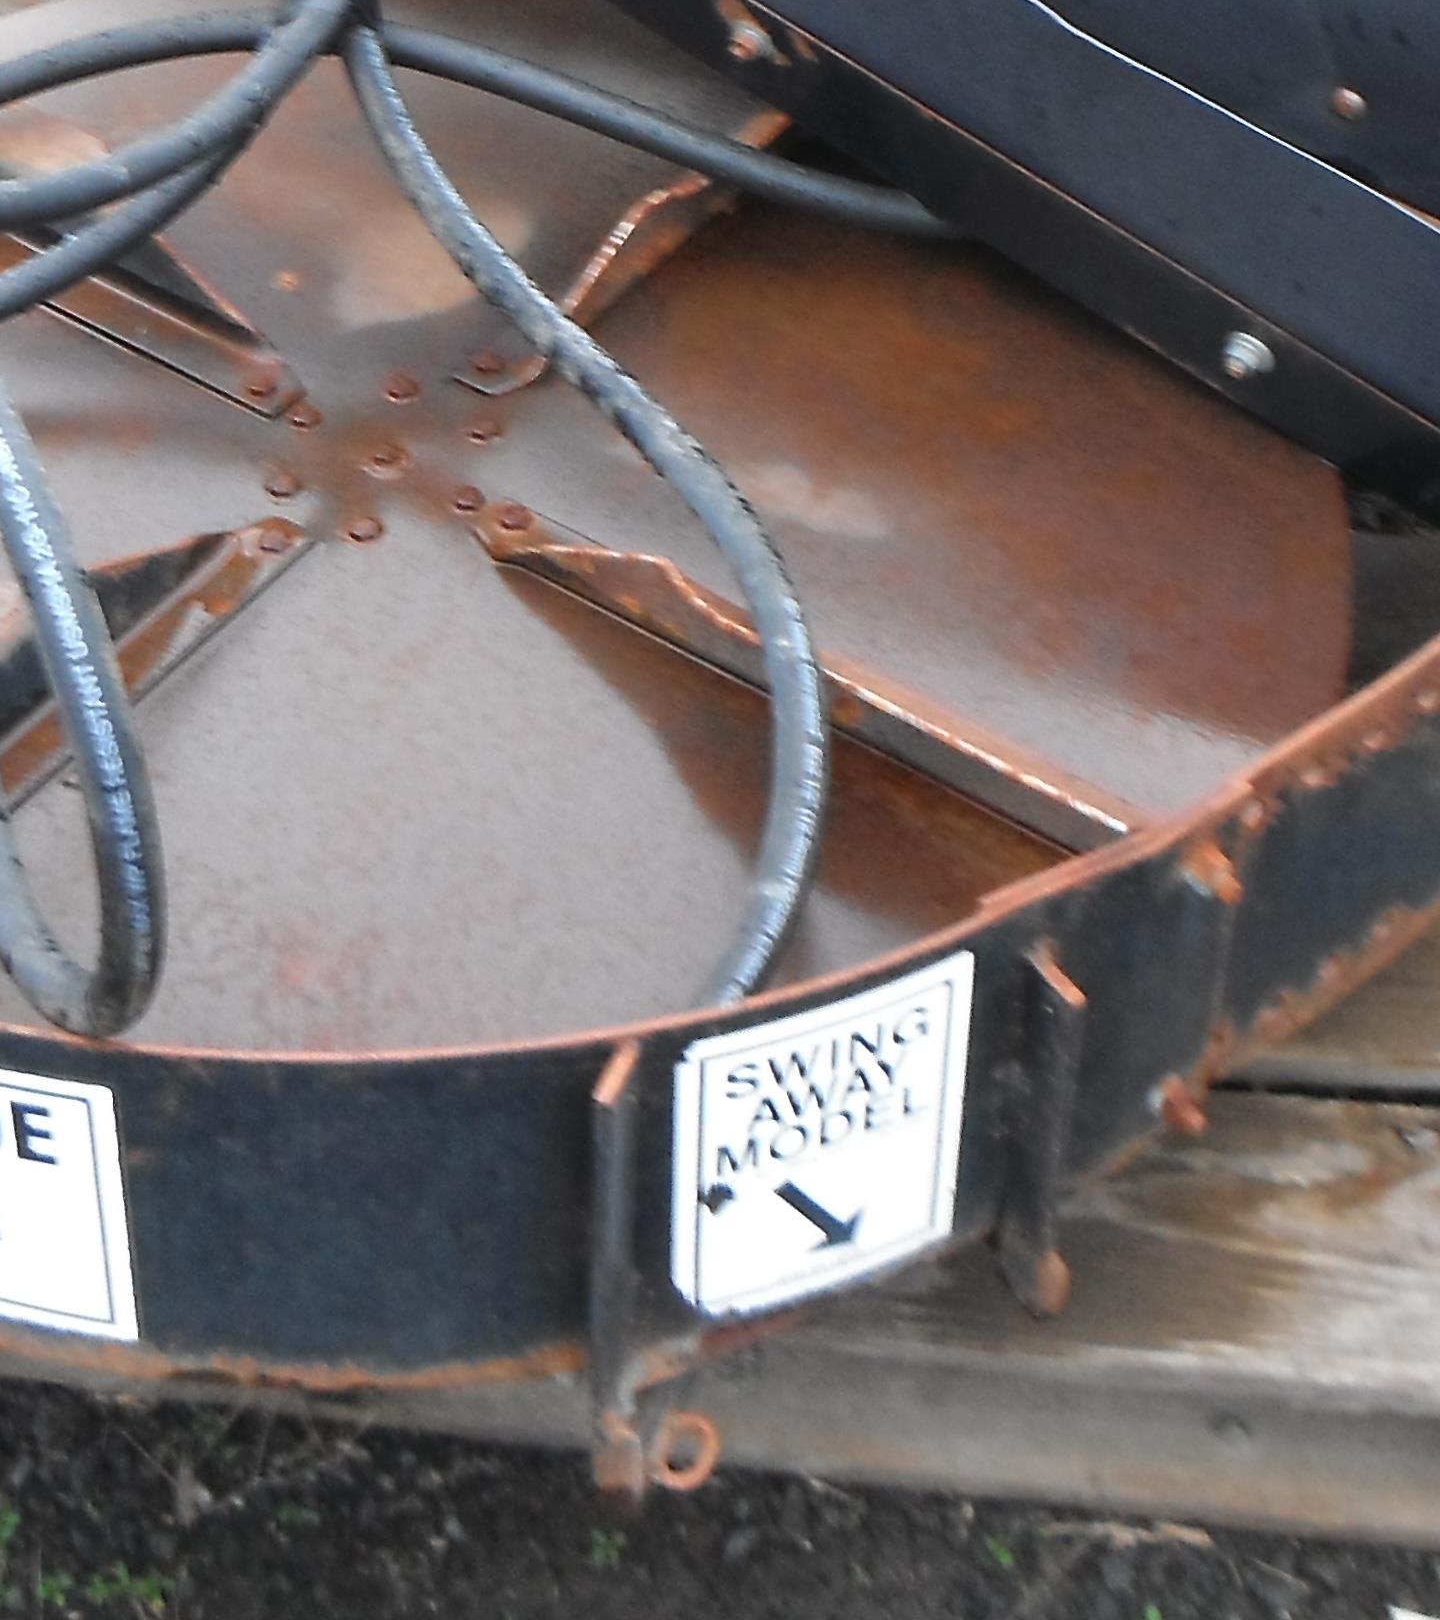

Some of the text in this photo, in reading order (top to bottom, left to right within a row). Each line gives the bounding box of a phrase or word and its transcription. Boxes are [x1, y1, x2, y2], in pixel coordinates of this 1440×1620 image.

[725, 1006, 929, 1099] SWING
[748, 1048, 908, 1135] AWAY
[716, 1087, 928, 1177] MODEL
